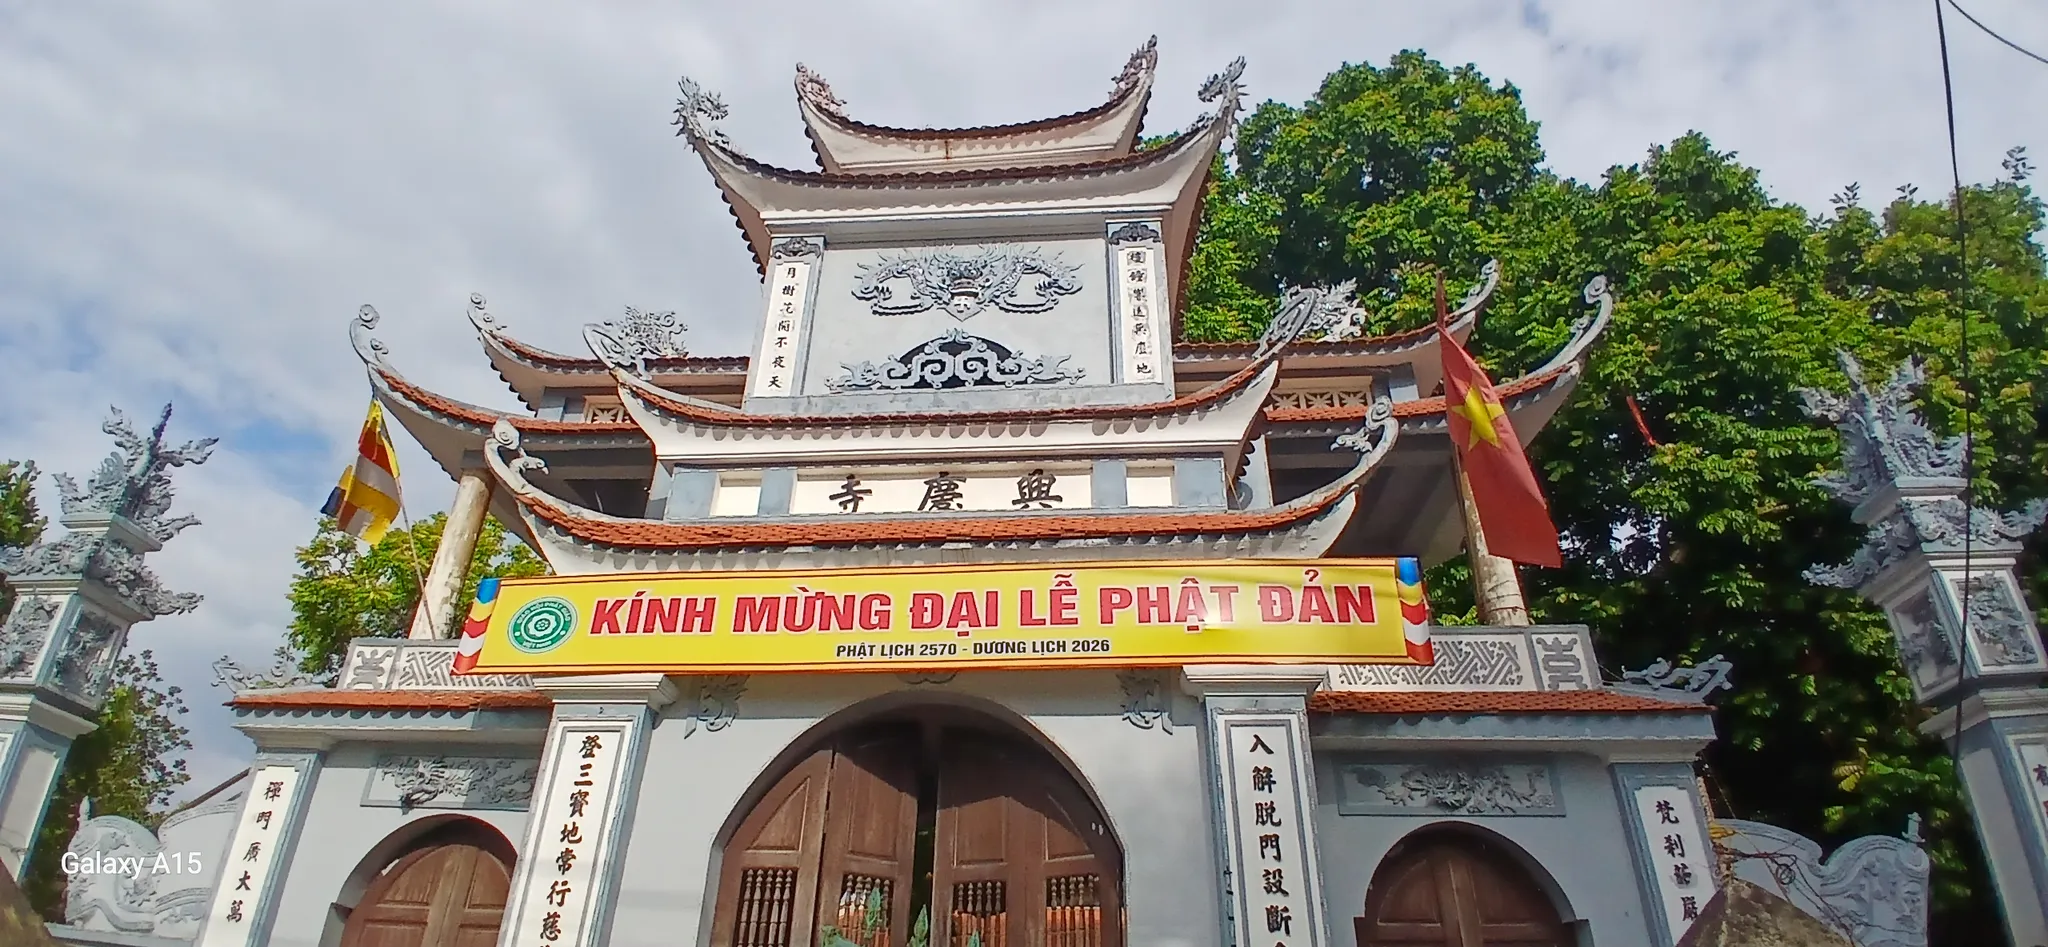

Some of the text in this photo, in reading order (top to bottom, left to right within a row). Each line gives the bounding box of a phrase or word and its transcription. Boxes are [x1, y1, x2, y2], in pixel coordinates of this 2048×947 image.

[590, 569, 1376, 637] KÍNH MỪNG ĐẠI LỄ PHẬT ĐẢN
[836, 642, 876, 660] PHẬT
[880, 643, 914, 660] LỊCH
[919, 643, 957, 656] 2570
[973, 640, 1027, 655] DƯƠNG
[1031, 640, 1067, 656] LỊCH
[1071, 639, 1110, 653] 2026
[540, 734, 602, 947] 登三寶地常行慈
